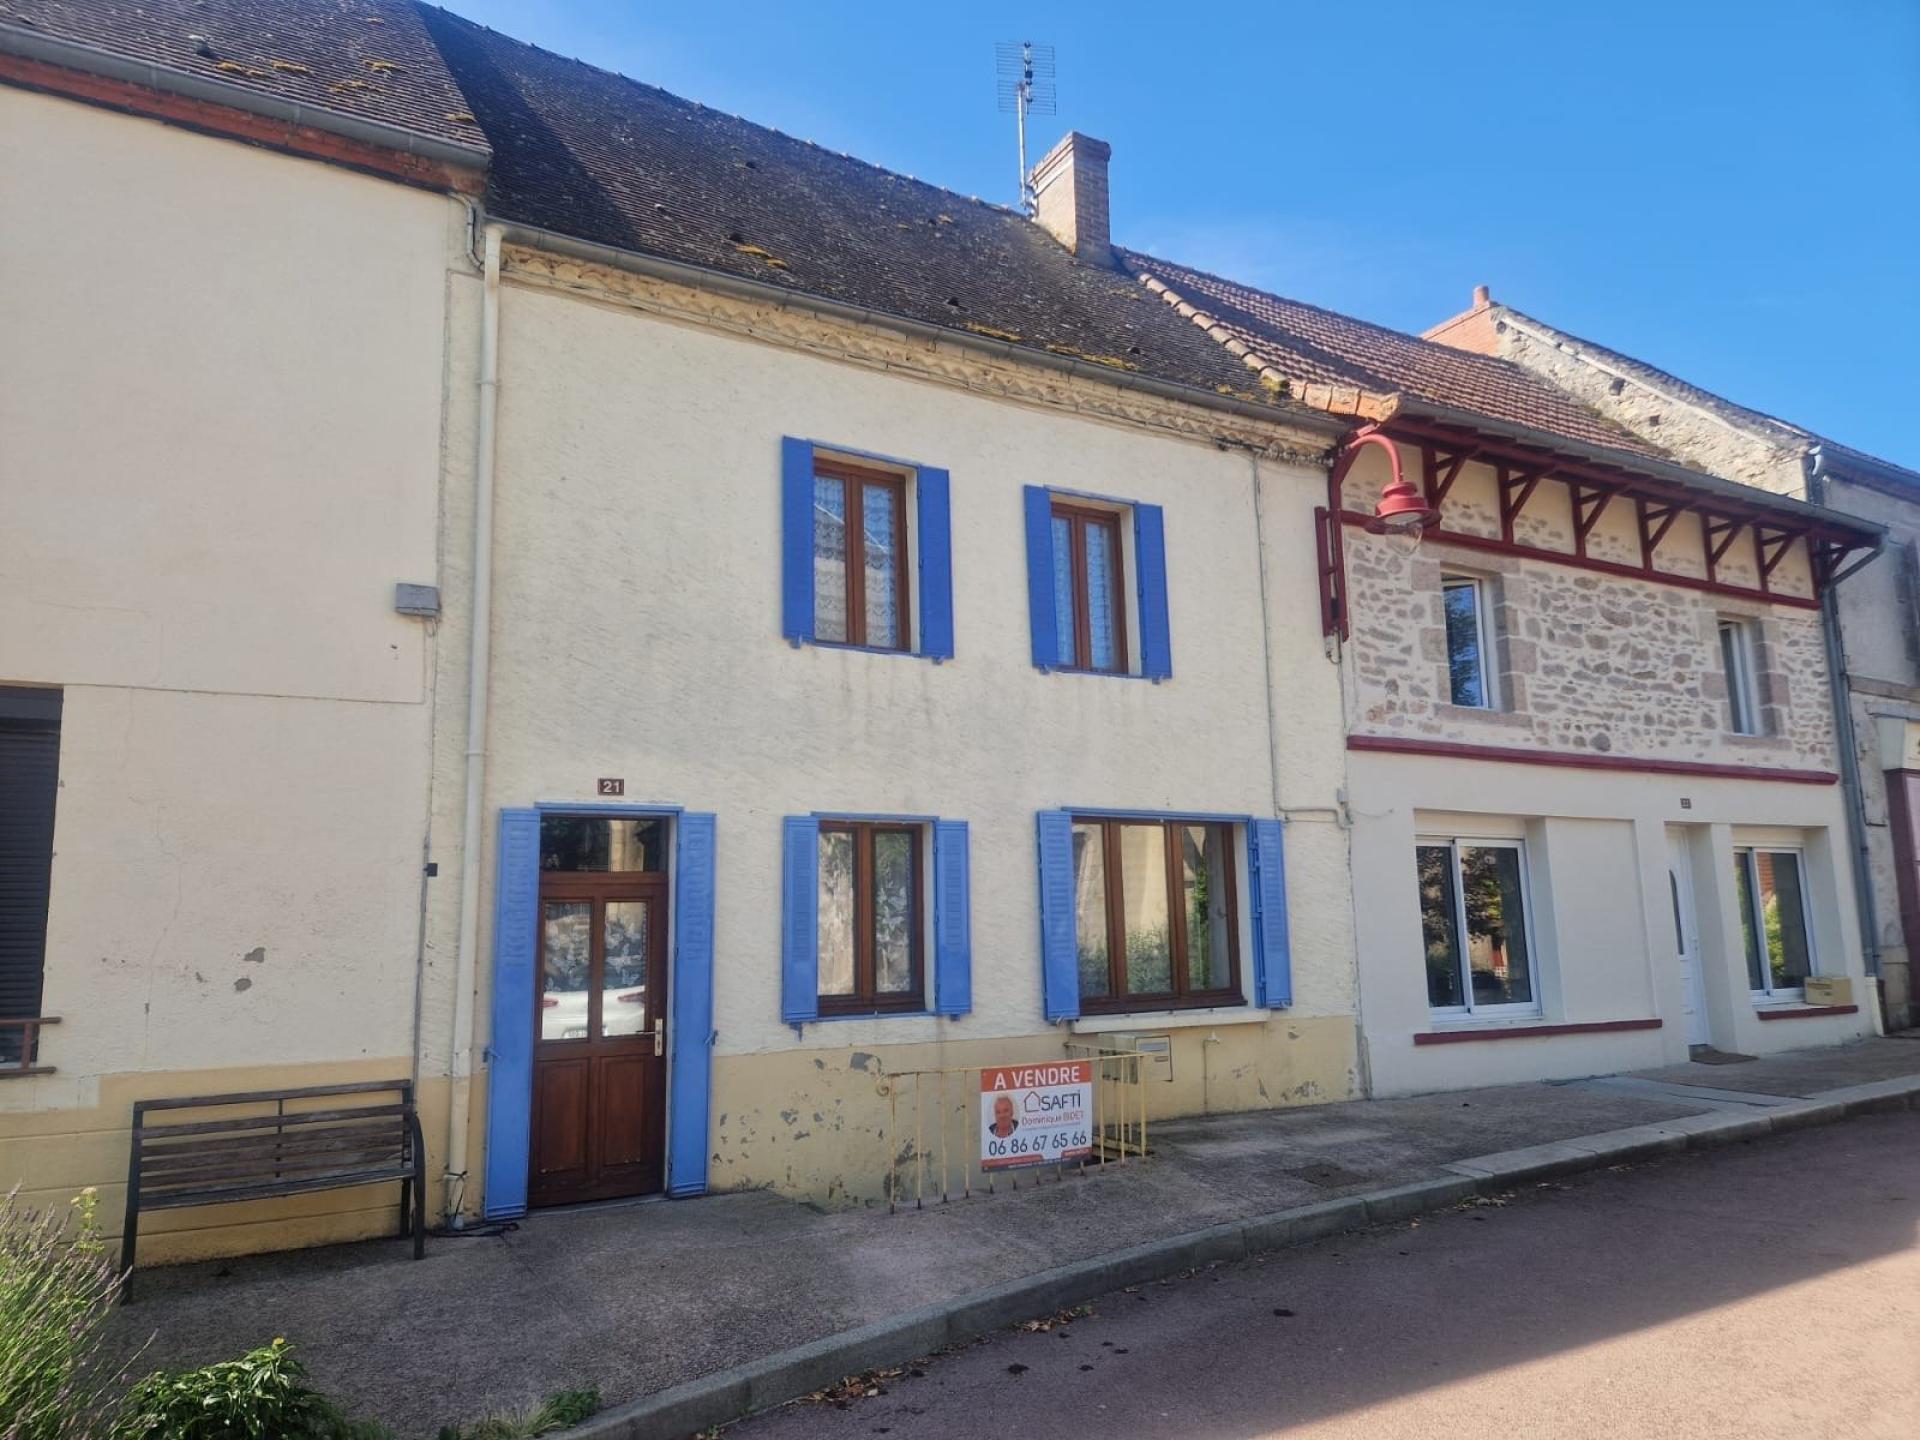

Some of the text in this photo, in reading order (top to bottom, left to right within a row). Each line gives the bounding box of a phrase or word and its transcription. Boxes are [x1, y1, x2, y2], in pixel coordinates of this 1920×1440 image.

[603, 780, 620, 793] 21
[994, 1066, 1081, 1090] A VENDRE
[988, 1130, 1087, 1156] 06 86 67 65 66
